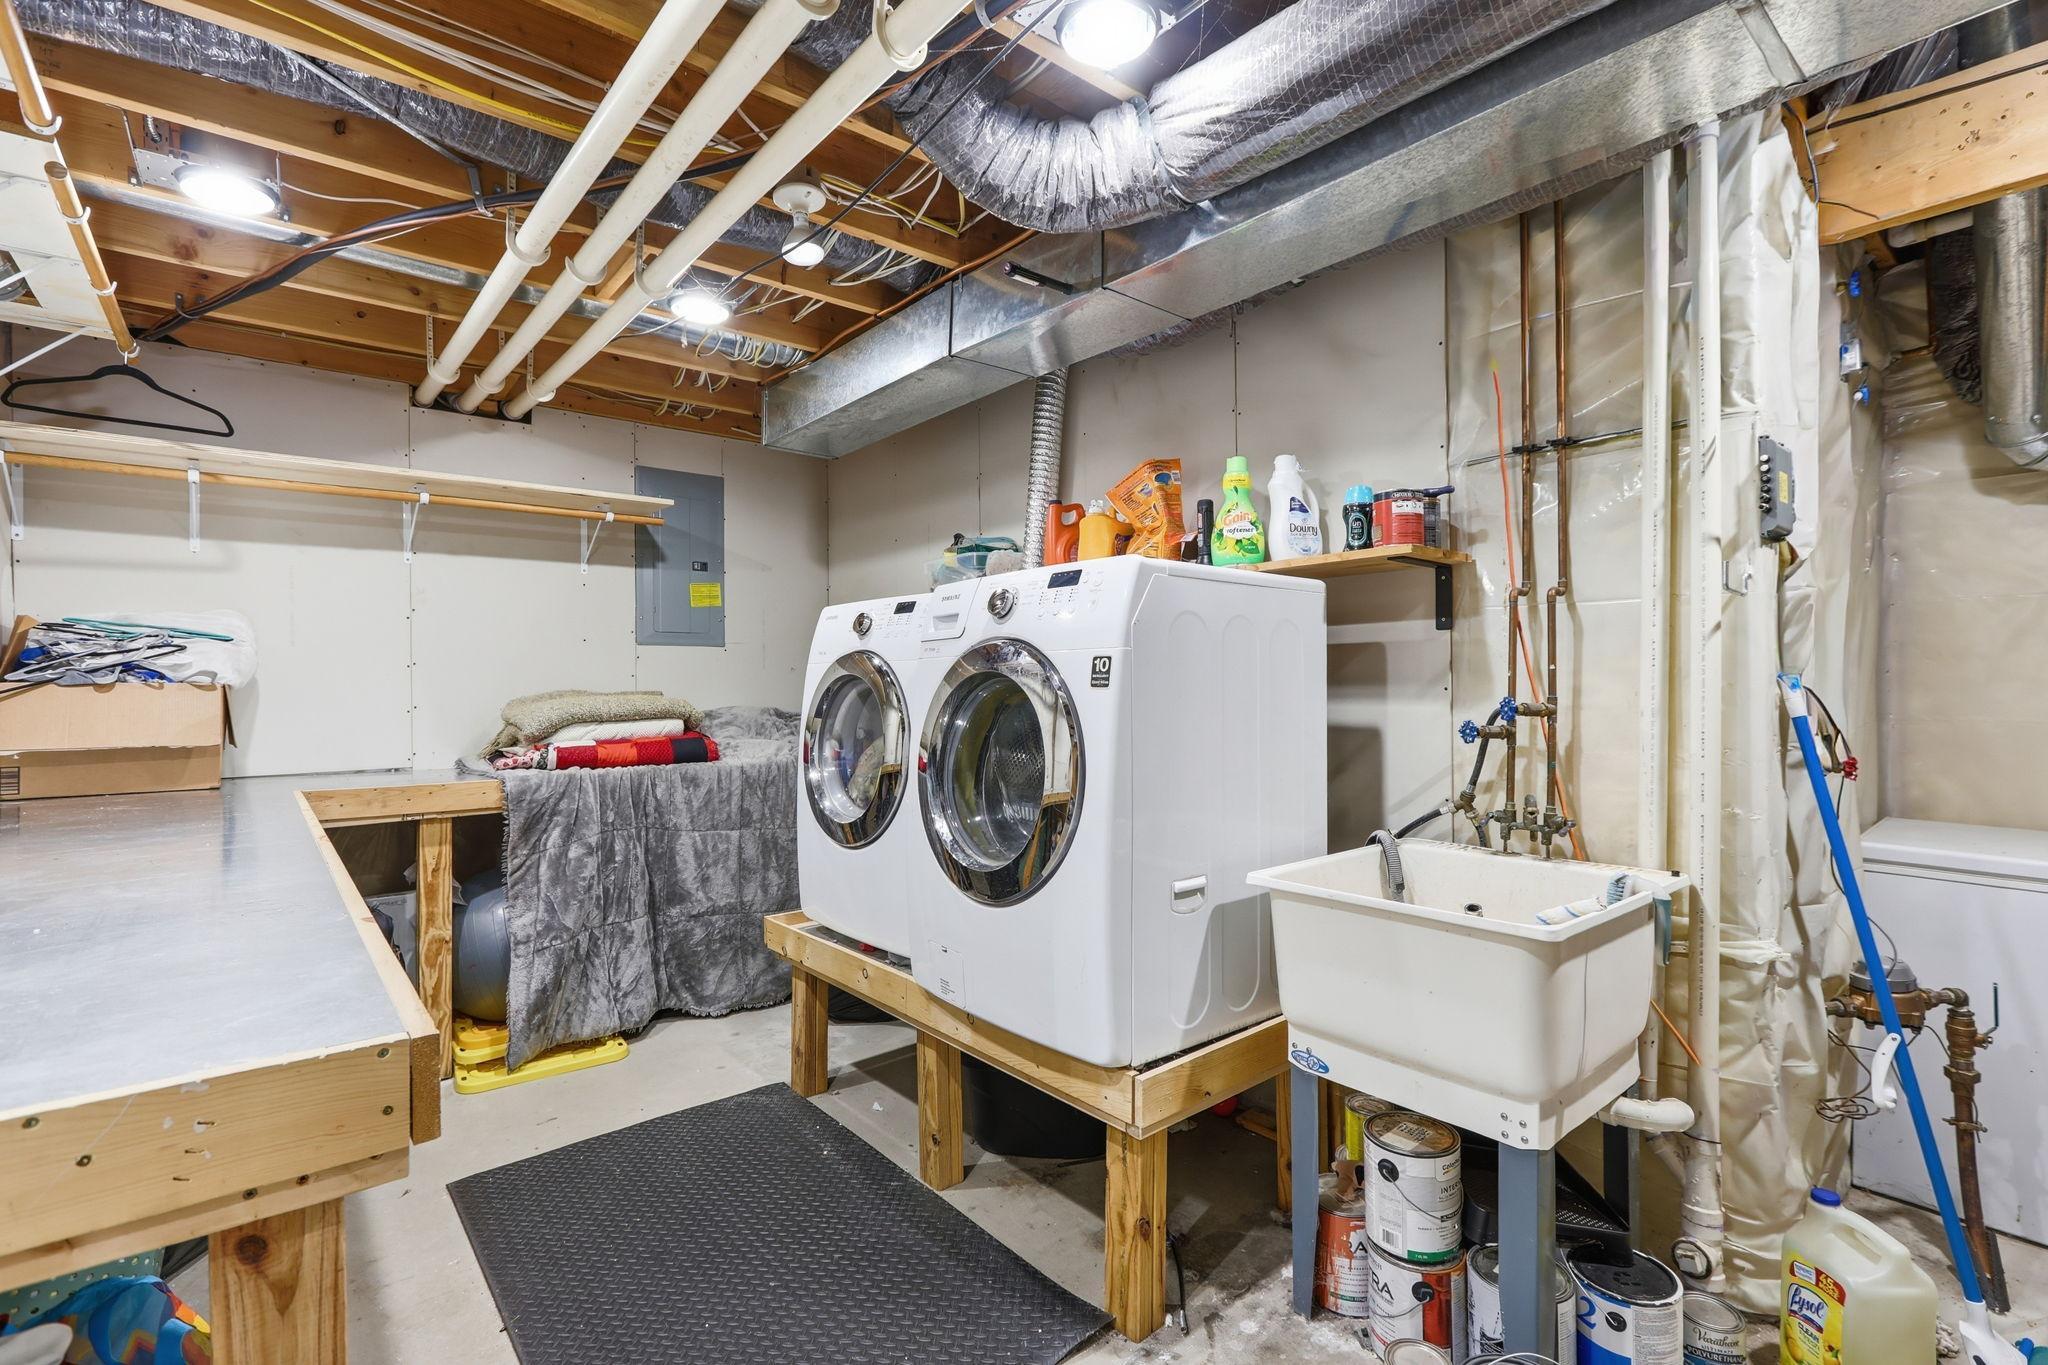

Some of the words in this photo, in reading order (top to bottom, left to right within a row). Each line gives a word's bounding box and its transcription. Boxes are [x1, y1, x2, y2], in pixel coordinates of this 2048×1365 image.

[1222, 511, 1252, 527] Gain
[1226, 526, 1255, 536] softener
[1289, 522, 1319, 537] Downy
[1094, 657, 1110, 672] 10
[1790, 1285, 1825, 1319] Lysol
[1577, 1295, 1598, 1330] 2
[1692, 1326, 1740, 1348] Varathane
